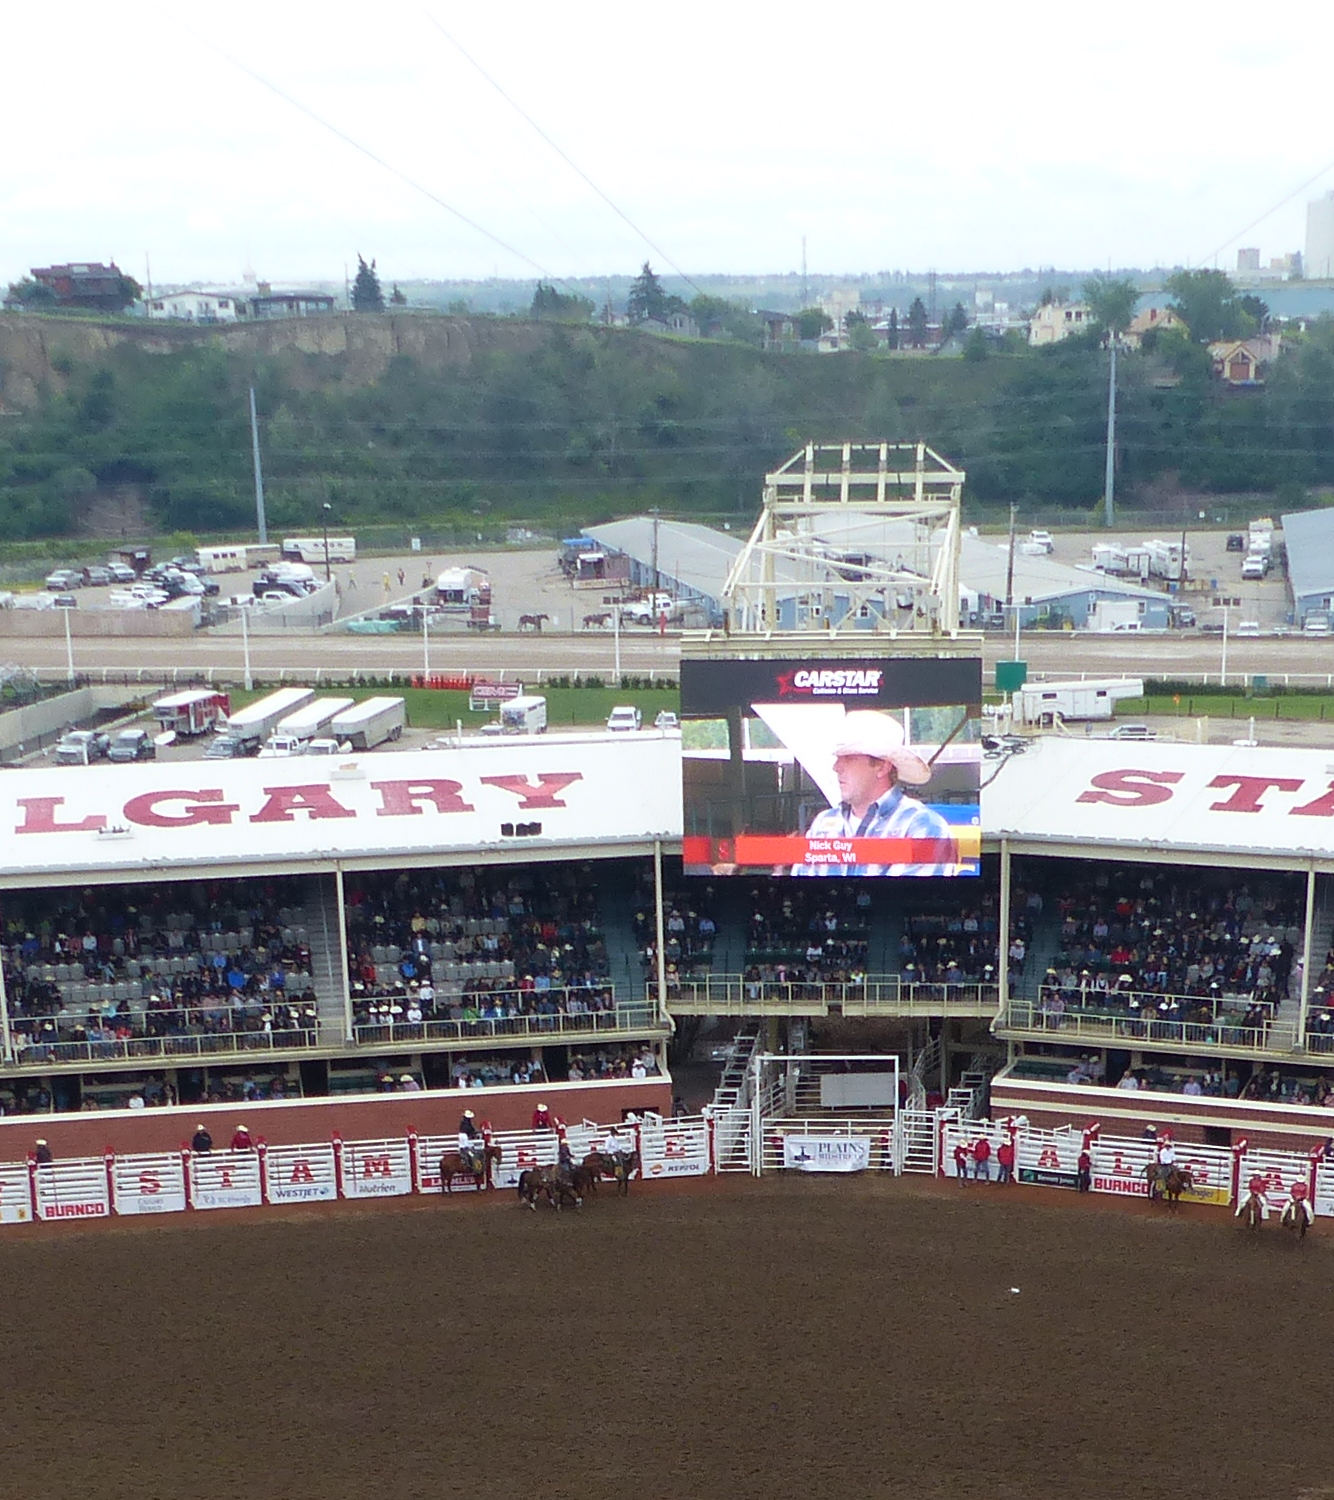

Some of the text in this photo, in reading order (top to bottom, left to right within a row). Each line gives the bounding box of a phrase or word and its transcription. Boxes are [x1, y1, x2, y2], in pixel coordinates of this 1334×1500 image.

[794, 671, 880, 687] CARSTAR
[809, 840, 852, 853] Nick Guy
[805, 852, 856, 864] Sparta, WI
[819, 1142, 864, 1153] PLAINS
[1094, 1177, 1149, 1195] BURNCO
[275, 1187, 319, 1199] WESTJET
[45, 1203, 105, 1218] BURNCO
